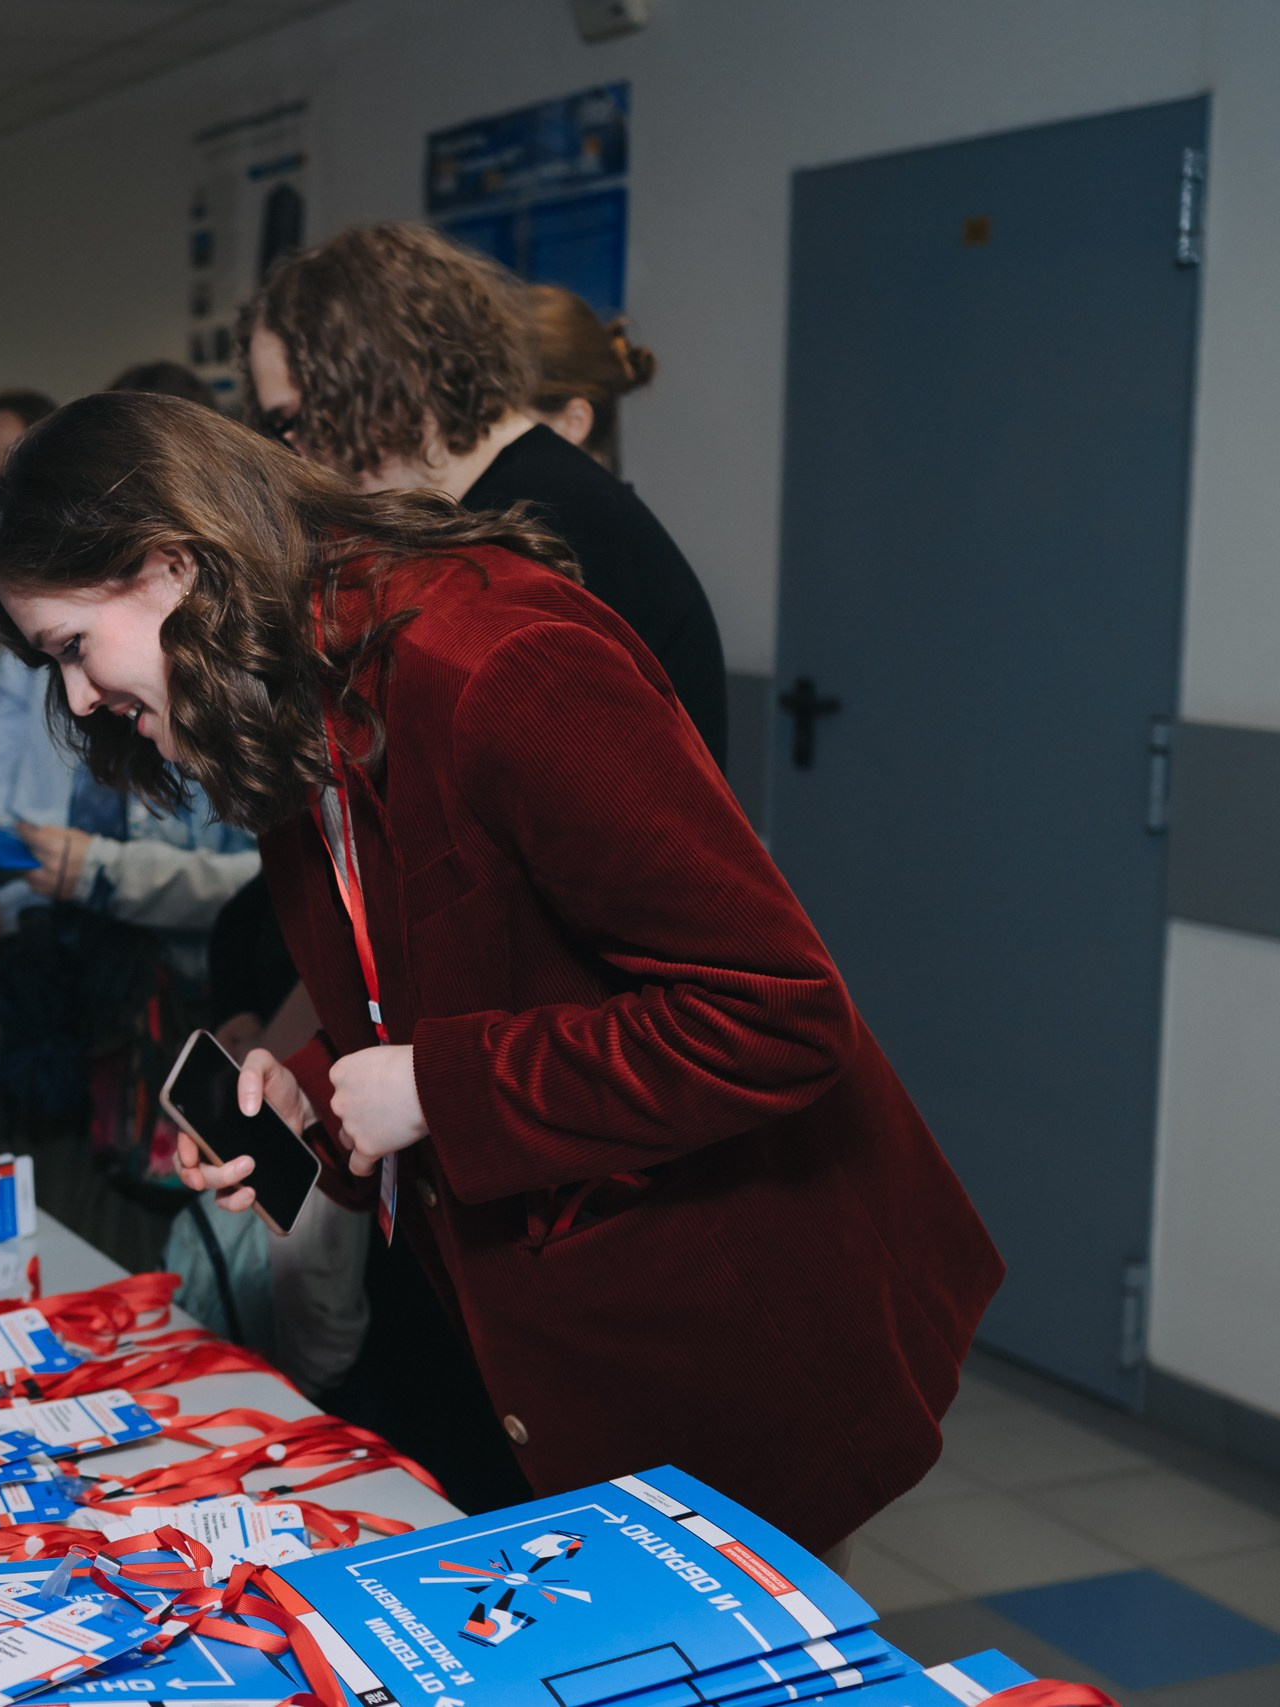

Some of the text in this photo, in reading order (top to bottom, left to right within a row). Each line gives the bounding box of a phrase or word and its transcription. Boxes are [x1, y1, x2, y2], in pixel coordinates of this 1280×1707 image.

[619, 1523, 722, 1593] ОБРАТНО
[356, 1578, 475, 1686] К ЭКСПЕРИМЕНТУ
[708, 1593, 742, 1611] И
[364, 1616, 446, 1694] ОТ ТЕОРИИ
